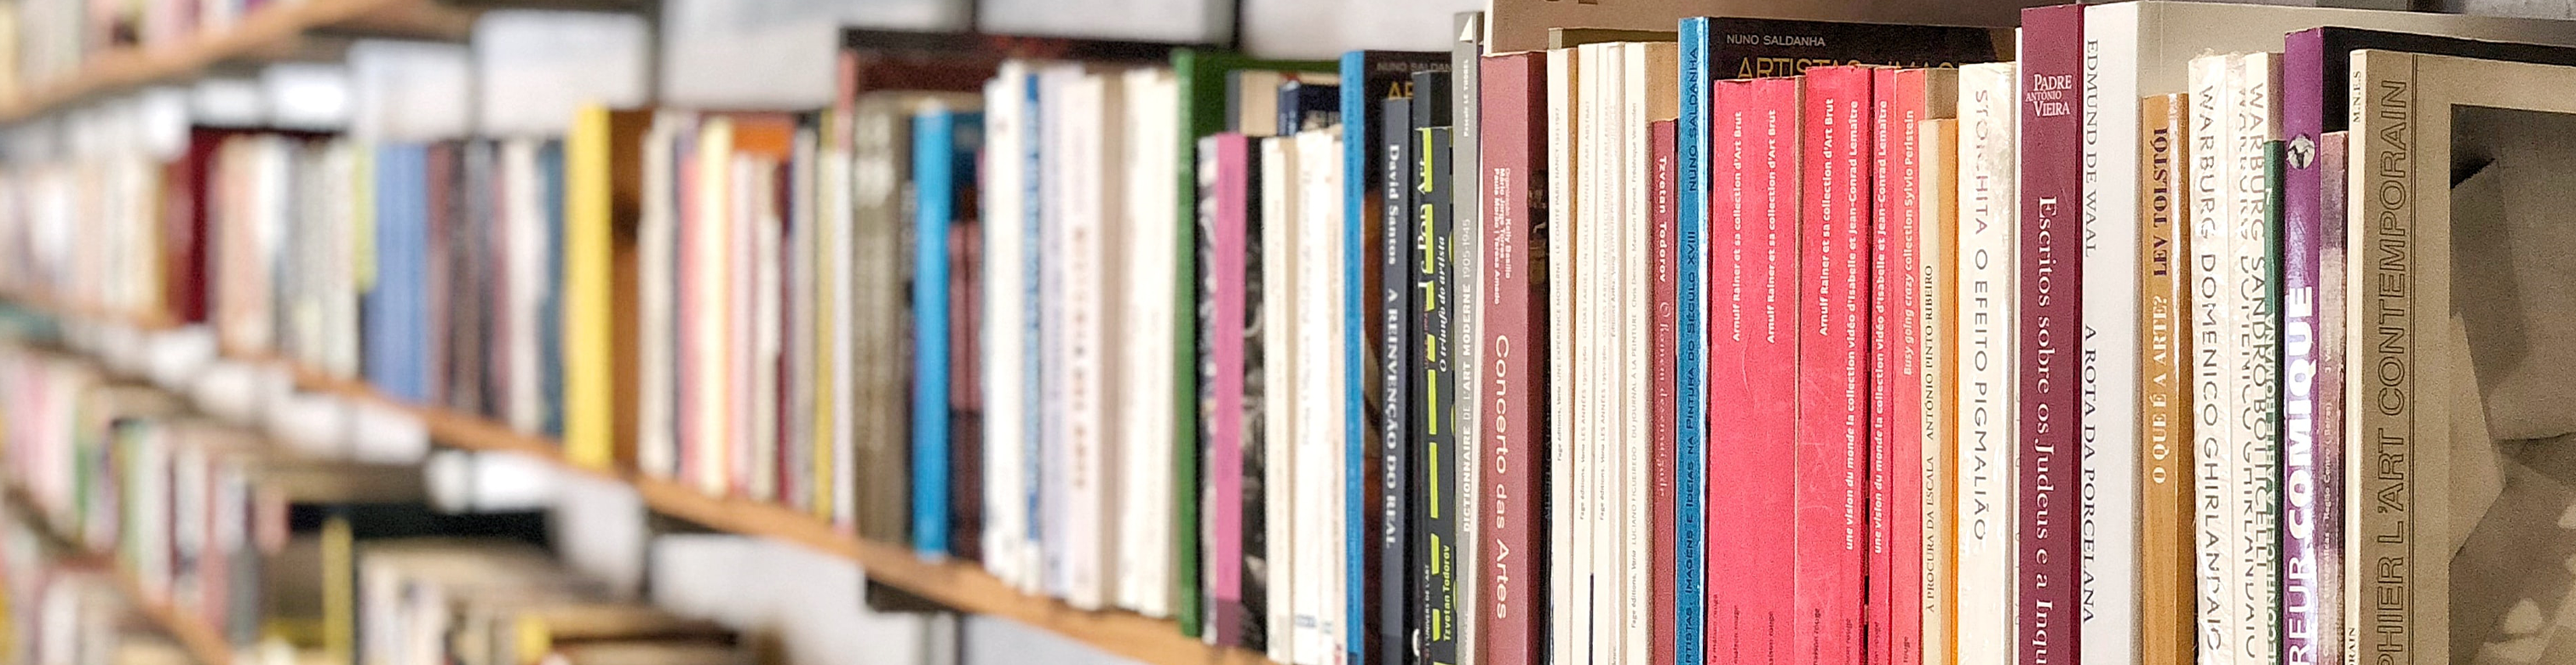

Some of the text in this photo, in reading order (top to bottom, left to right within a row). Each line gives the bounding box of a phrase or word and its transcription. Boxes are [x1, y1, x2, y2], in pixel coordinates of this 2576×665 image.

[1727, 35, 1826, 47] NUNO SALDANHA
[1737, 56, 1862, 79] ARTIS
[2033, 73, 2073, 92] PADRE
[2033, 100, 2071, 117] VIEIRA
[2084, 38, 2098, 258] EDMUND DE WAAL
[2249, 83, 2266, 242] WARBURG
[1659, 156, 1668, 283] Tzvetan Todorov
[1734, 172, 1742, 231] collection
[1734, 232, 1741, 246] sa
[1734, 249, 1741, 261] et
[1819, 99, 1833, 336] Arnulf Rainer et sa collection d'Art Brut
[1903, 110, 1916, 375] Busy going crazy collection Sylvio Perlstein
[2038, 196, 2058, 307] Escritos
[2378, 80, 2407, 416] CONTEMPORAIN
[1436, 237, 1447, 373] O triunfo do artista
[1733, 263, 1741, 301] Rainer
[1975, 249, 1987, 271] O
[2148, 126, 2171, 484] O QUE É A ARTE? LEV TOLSTÓI
[1385, 144, 1400, 548] David Santos A REINVENÇÃO DO REAL
[1461, 219, 1472, 532] DICTIONNAIRE DE L'ART MODERNE 1905-1945
[1685, 48, 1698, 665] RTISTAS, IMAGENS E IDEIAS NA PINTURA DO SÉCULO XVIII NUNO SALDANHA
[1845, 100, 1858, 550] une vision du monde la collection vidéo d'Isabelle et Jean-Conrad Lemaître
[1975, 280, 1987, 372] EFEITO
[2037, 315, 2056, 394] sobre
[2198, 85, 2222, 651] WARBURG DOMENICO GHIRLANDAIO
[2251, 256, 2267, 388] SANDRO
[2265, 312, 2275, 413] ROMANA
[1924, 266, 1935, 613] À PROCURA DA ESCALA ANTÓNIO PINTO RIBEIRO
[1974, 381, 1989, 540] PIGMALIÃO
[2036, 403, 2050, 434] os
[2082, 324, 2096, 625] A ROTA DA PORCELANA
[2265, 422, 2275, 482] ARTE
[2287, 286, 2317, 664] REUR COMIQUE
[1495, 333, 1509, 620] Concerto das Artes
[2033, 438, 2056, 539] Judeus
[2266, 490, 2275, 507] A
[2377, 428, 2405, 544] L'ART
[1441, 545, 1452, 642] Tzvetan Todorov
[2036, 548, 2048, 565] e
[2036, 573, 2047, 589] a
